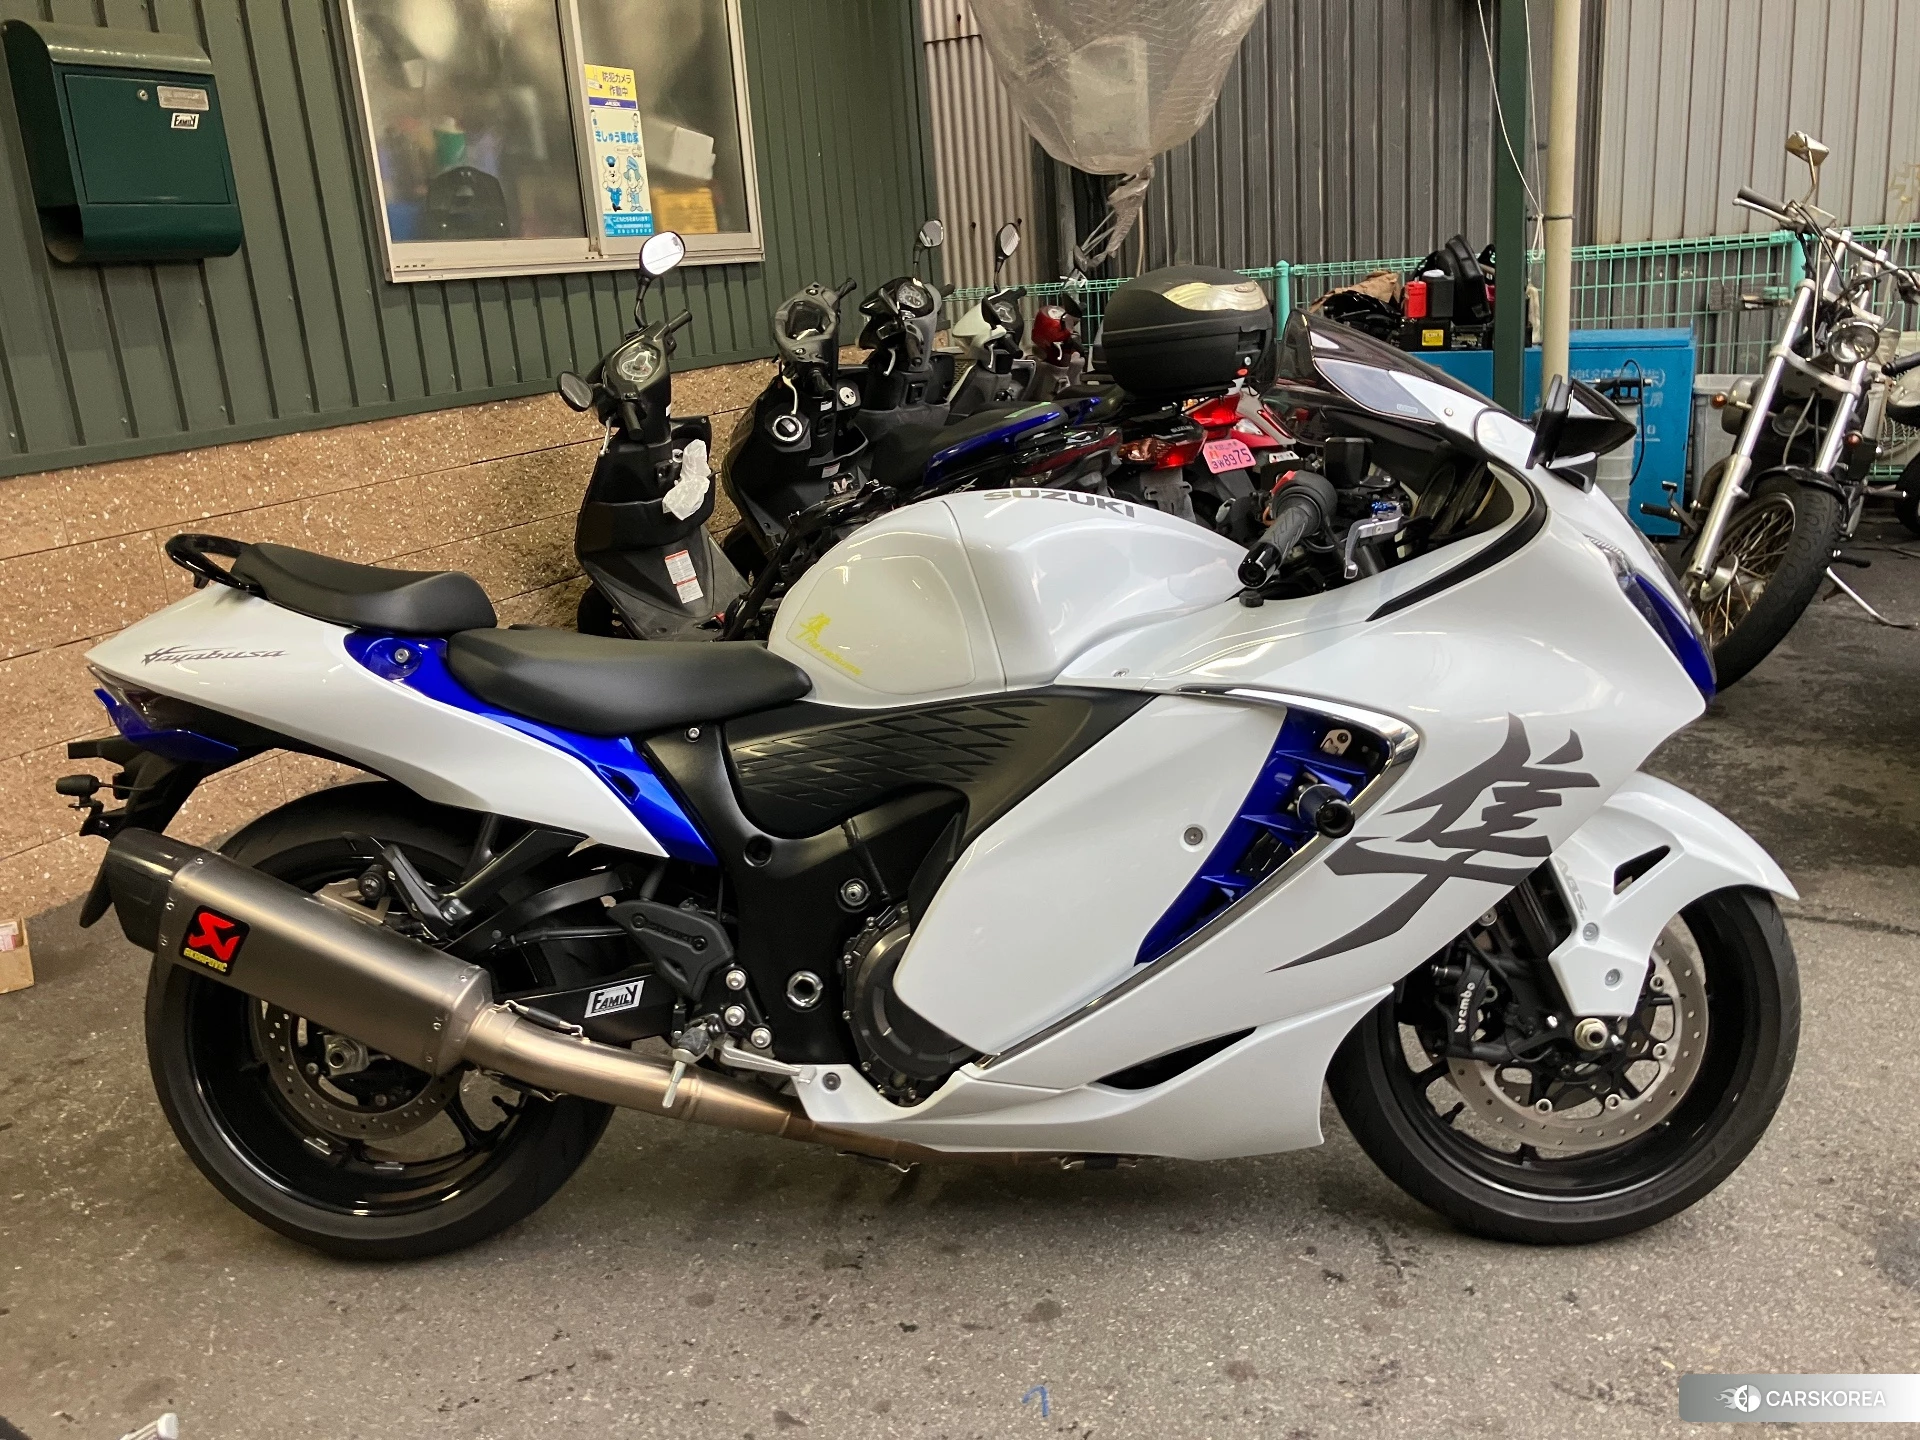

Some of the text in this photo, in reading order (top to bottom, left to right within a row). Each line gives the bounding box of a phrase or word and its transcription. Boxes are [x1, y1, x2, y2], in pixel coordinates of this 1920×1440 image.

[602, 71, 632, 84] 防犯カメラ
[609, 85, 628, 97] 作動中
[174, 115, 196, 127] FAMILY
[984, 489, 1135, 518] SUZUKI
[141, 645, 290, 666] Hayabusa
[1264, 711, 1601, 974] 隼
[592, 985, 638, 1014] FAMILY
[1454, 982, 1476, 1033] brembo
